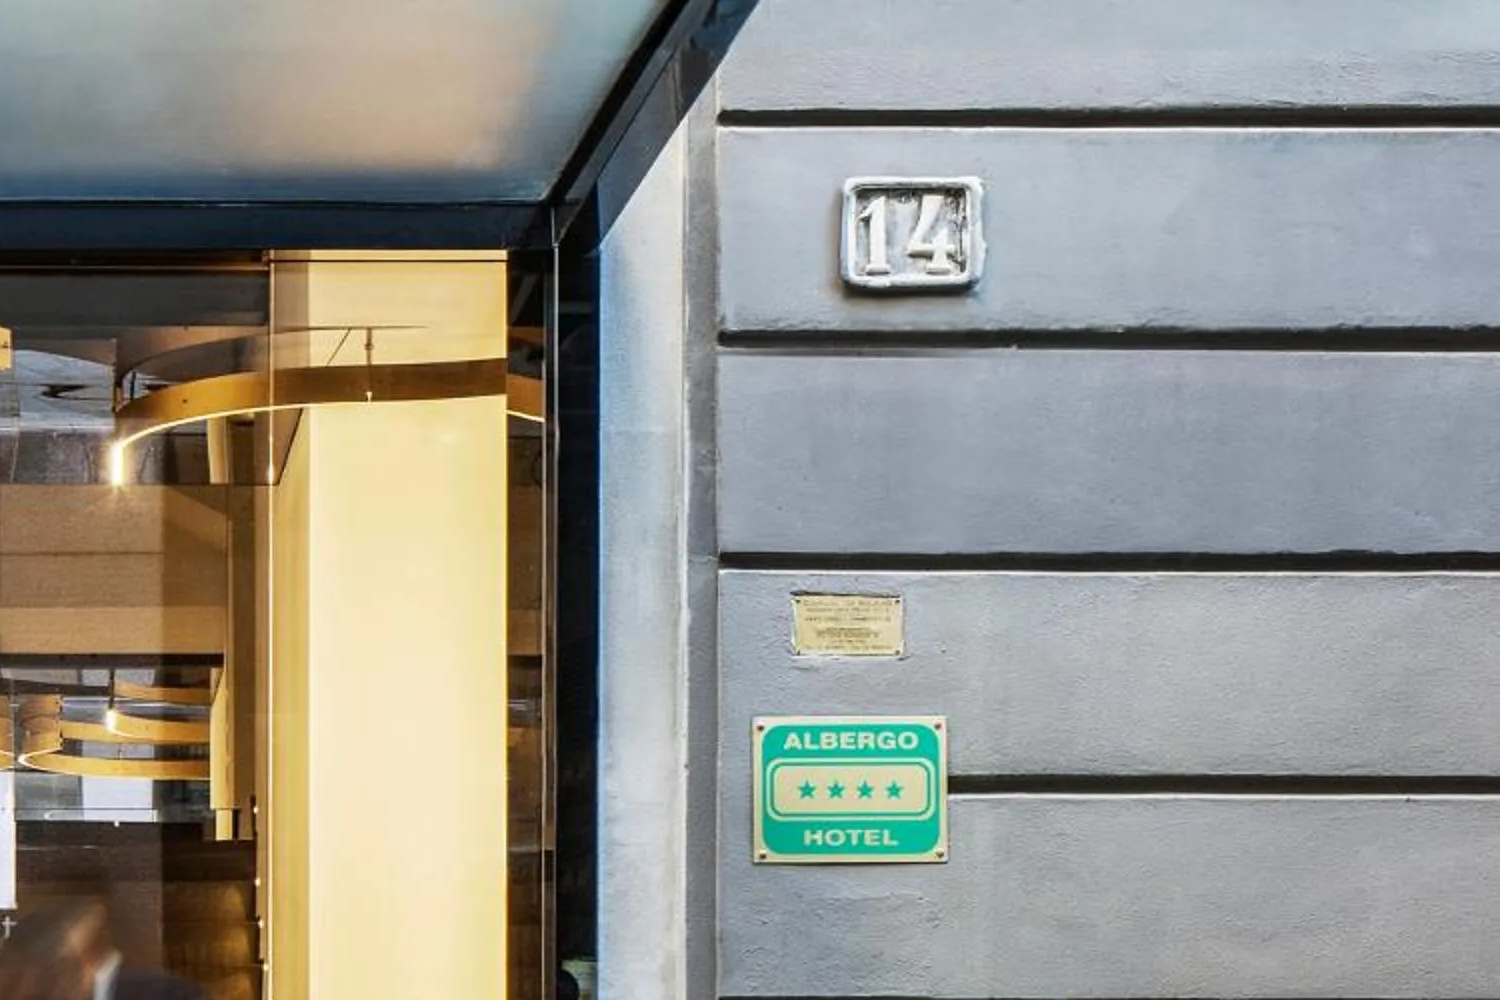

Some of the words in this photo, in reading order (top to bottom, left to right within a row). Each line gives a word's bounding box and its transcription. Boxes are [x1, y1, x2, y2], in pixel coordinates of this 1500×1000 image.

[858, 194, 955, 274] 14
[783, 731, 919, 750] ALBERGO
[803, 829, 899, 847] HOTEL
